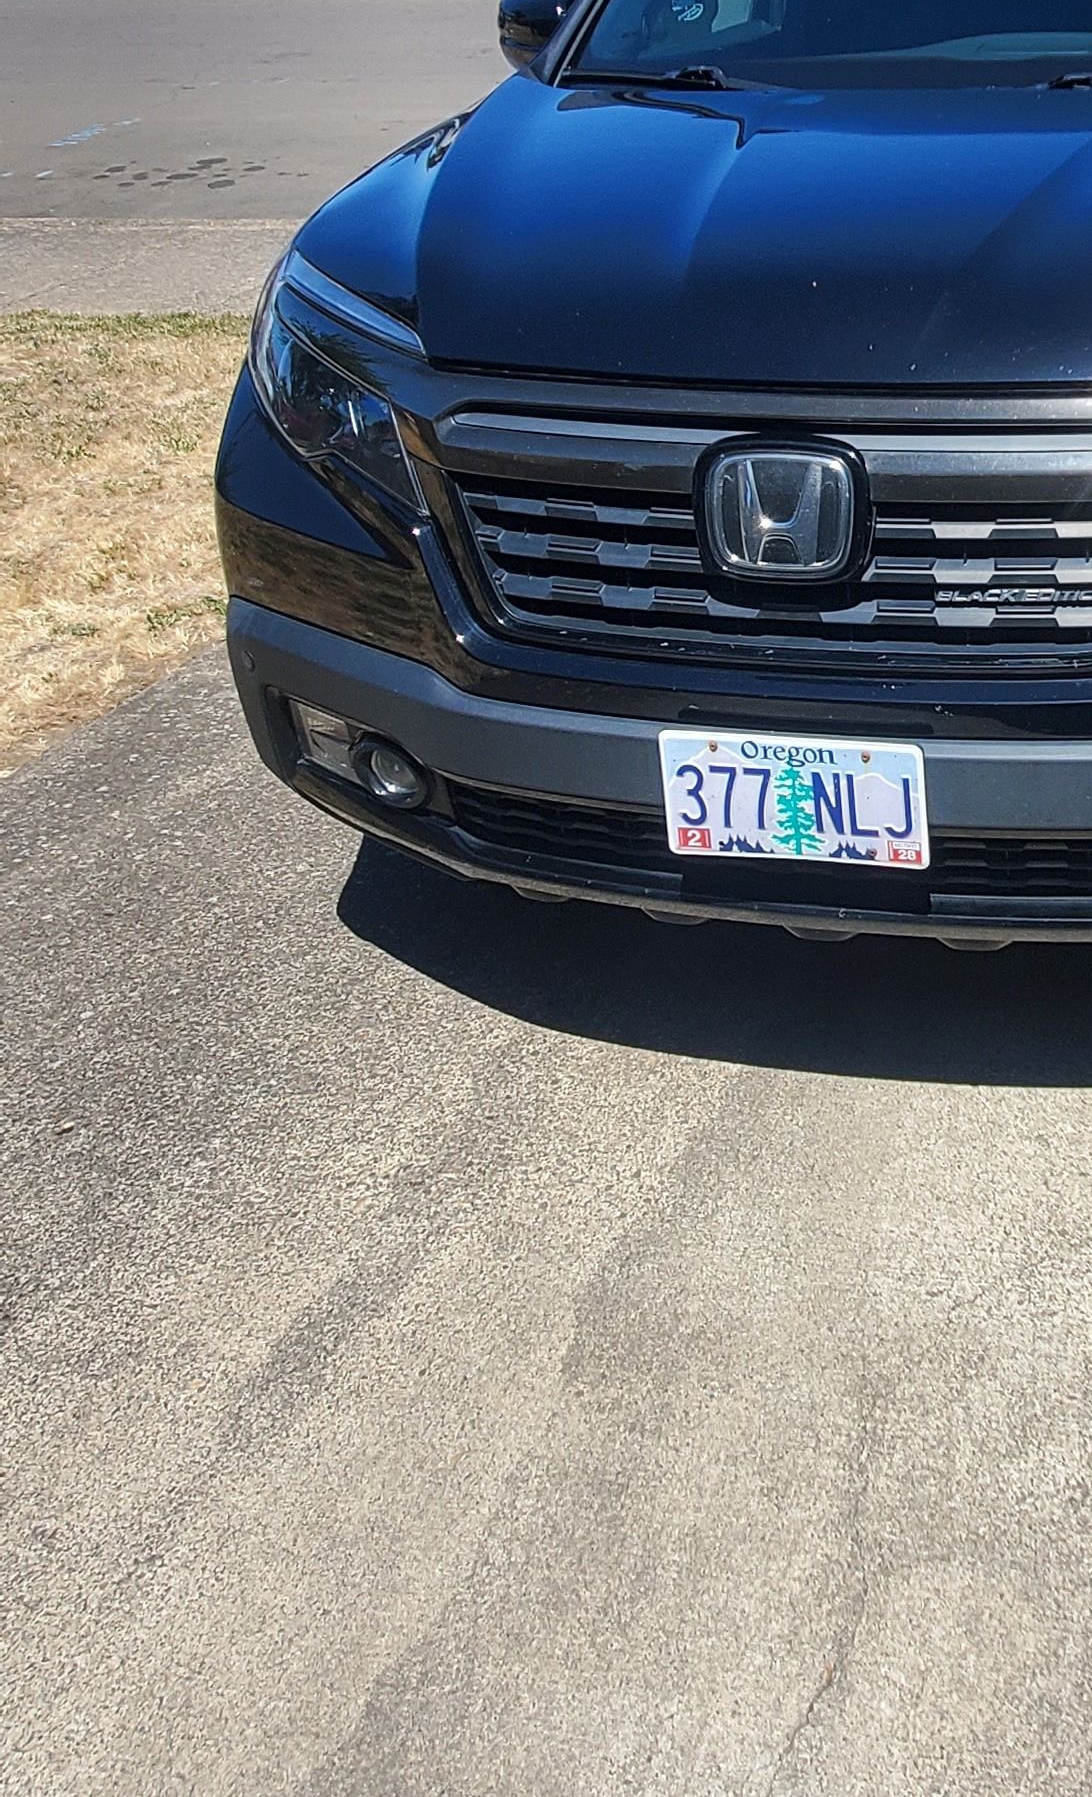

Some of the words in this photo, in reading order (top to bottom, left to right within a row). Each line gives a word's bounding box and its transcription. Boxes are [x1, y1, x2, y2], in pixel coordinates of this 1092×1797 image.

[935, 587, 1016, 603] BLACK
[740, 739, 838, 768] Oregon
[675, 763, 772, 830] 377
[811, 770, 913, 840] NLJ
[686, 829, 701, 847] 2
[897, 849, 917, 861] 28
